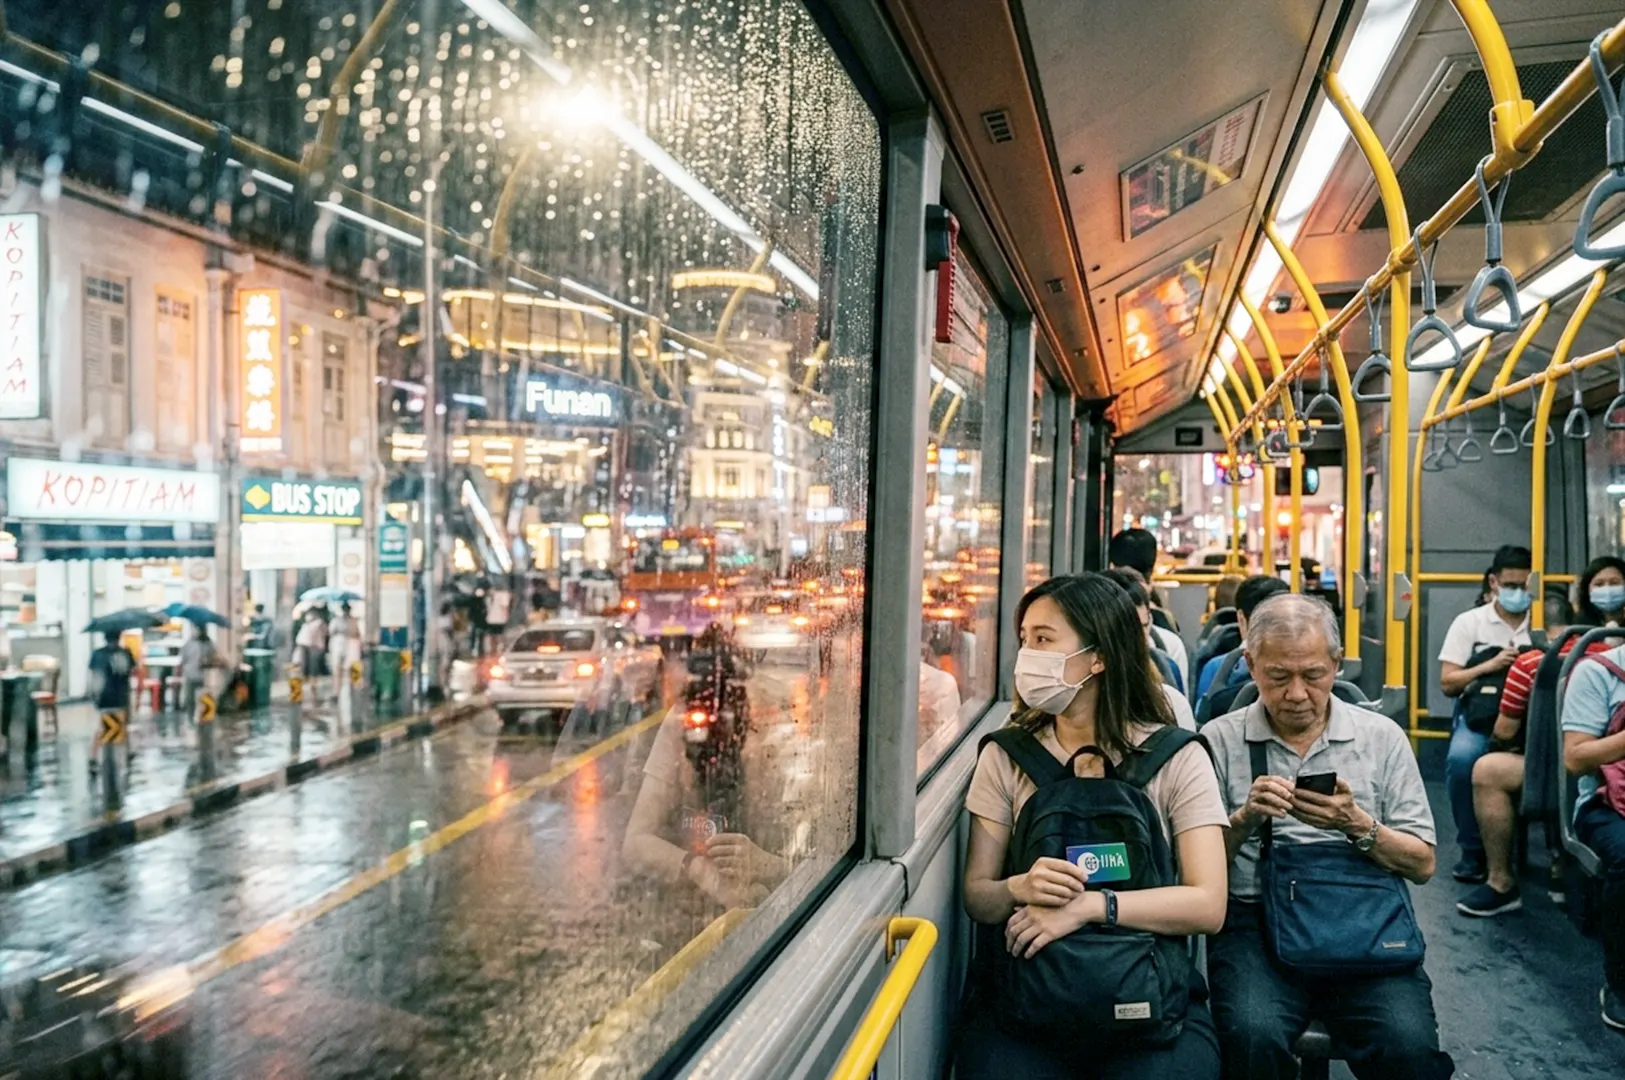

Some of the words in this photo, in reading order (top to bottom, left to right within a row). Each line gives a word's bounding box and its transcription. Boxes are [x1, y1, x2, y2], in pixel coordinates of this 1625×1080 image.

[4, 221, 26, 394] KOPITIAM
[526, 381, 612, 417] Funan
[37, 471, 196, 511] KOPITIAM
[271, 482, 311, 514] BUS
[313, 485, 361, 515] STOP
